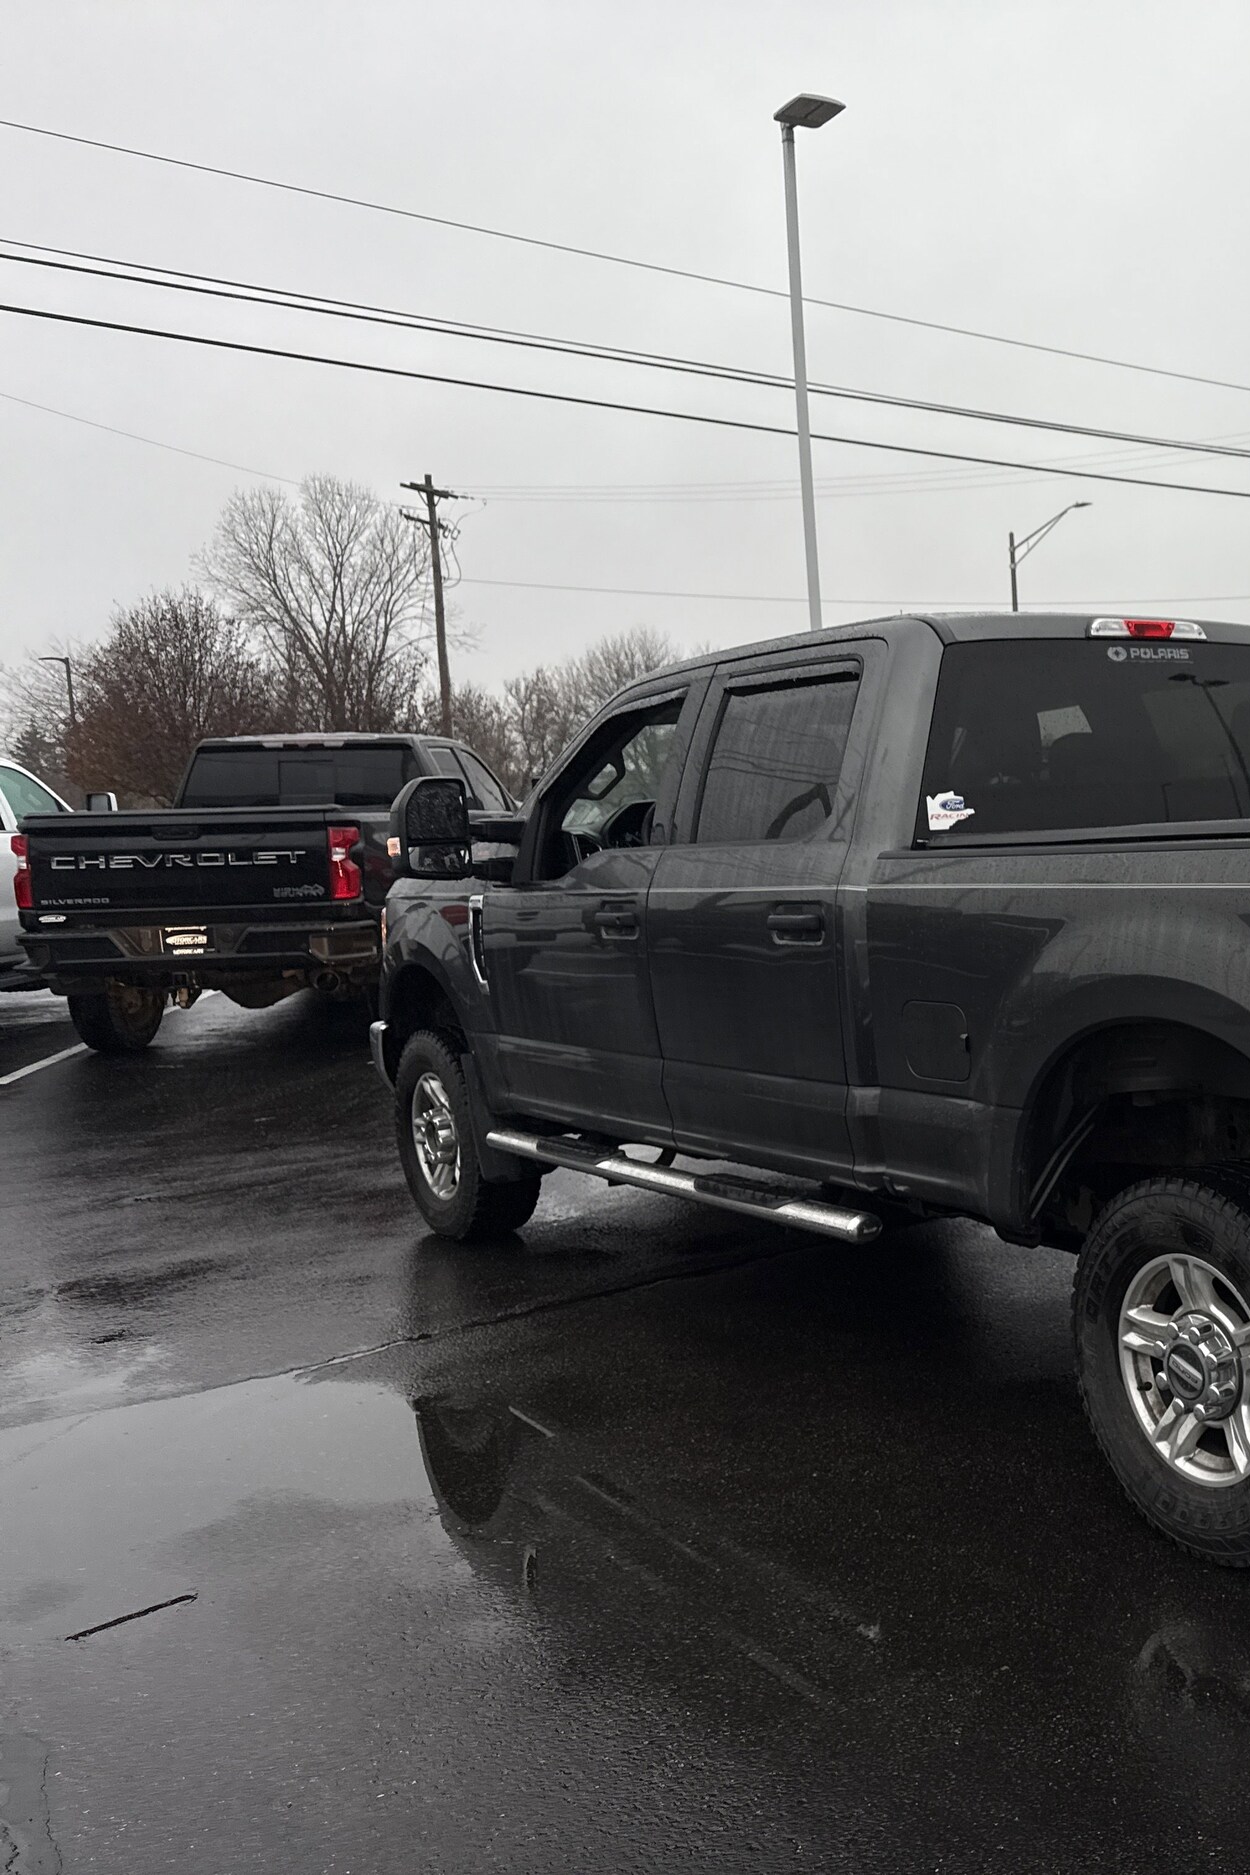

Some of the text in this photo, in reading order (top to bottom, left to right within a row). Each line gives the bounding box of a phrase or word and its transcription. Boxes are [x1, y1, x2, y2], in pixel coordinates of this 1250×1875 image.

[1130, 648, 1189, 659] POLARIS
[945, 800, 965, 810] Ford
[51, 851, 306, 870] CHEVROLET
[41, 897, 110, 906] SILVERADO
